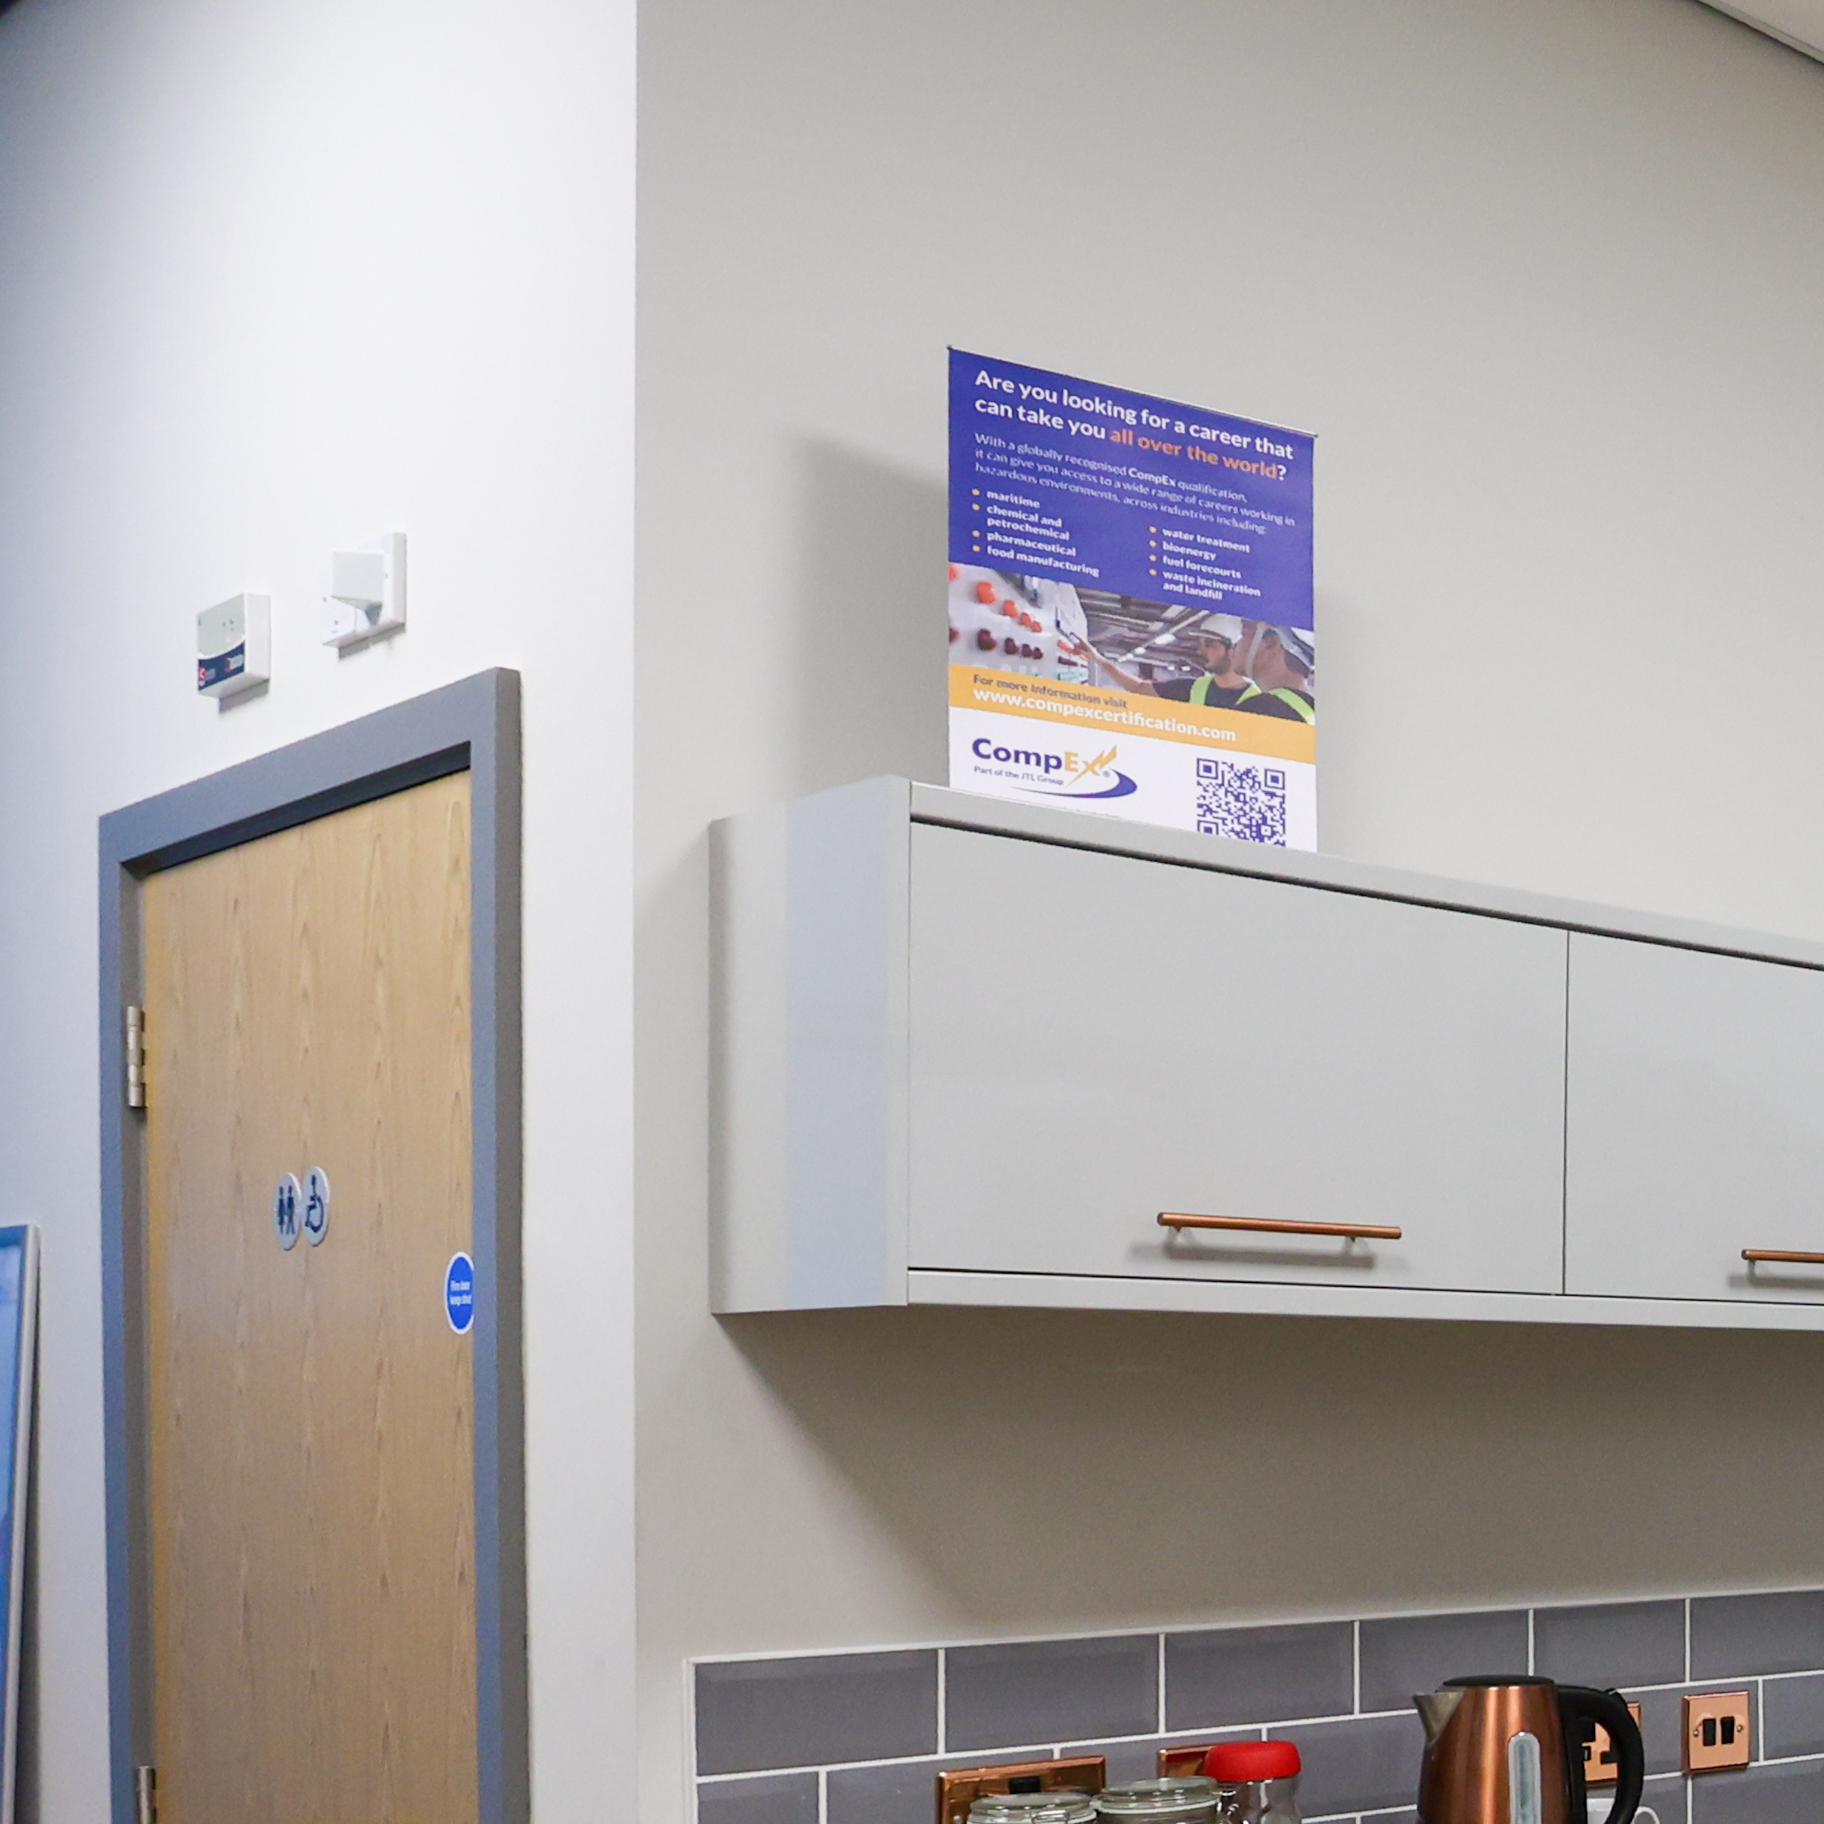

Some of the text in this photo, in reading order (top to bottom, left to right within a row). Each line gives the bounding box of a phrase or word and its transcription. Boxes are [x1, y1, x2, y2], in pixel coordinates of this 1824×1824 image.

[975, 367, 1293, 459] Are you looking for a career that
[975, 397, 1286, 482] can take you all over the world?
[975, 432, 1246, 504] With a globally recognised CompEx qualification,
[975, 448, 1296, 527] it can give you access to a wide range of careers working in
[975, 461, 1266, 535] hazardous environments, across industries including:
[986, 489, 1039, 509] maritime
[986, 503, 1061, 528] chemical and
[986, 515, 1069, 541] petrochemical
[986, 530, 1075, 557] pharmaceutical
[1162, 527, 1249, 553] water treatment
[1162, 541, 1215, 562] bioenergy
[987, 545, 1099, 577] food manufacturing
[1162, 554, 1241, 579] fuel forecourts
[1162, 569, 1260, 597] waste incineration
[1162, 580, 1222, 600] and landfill
[974, 674, 1127, 708] For more information visit
[974, 687, 1235, 743] www.compexcertification.com
[974, 765, 1063, 787] Part of the JTL Group
